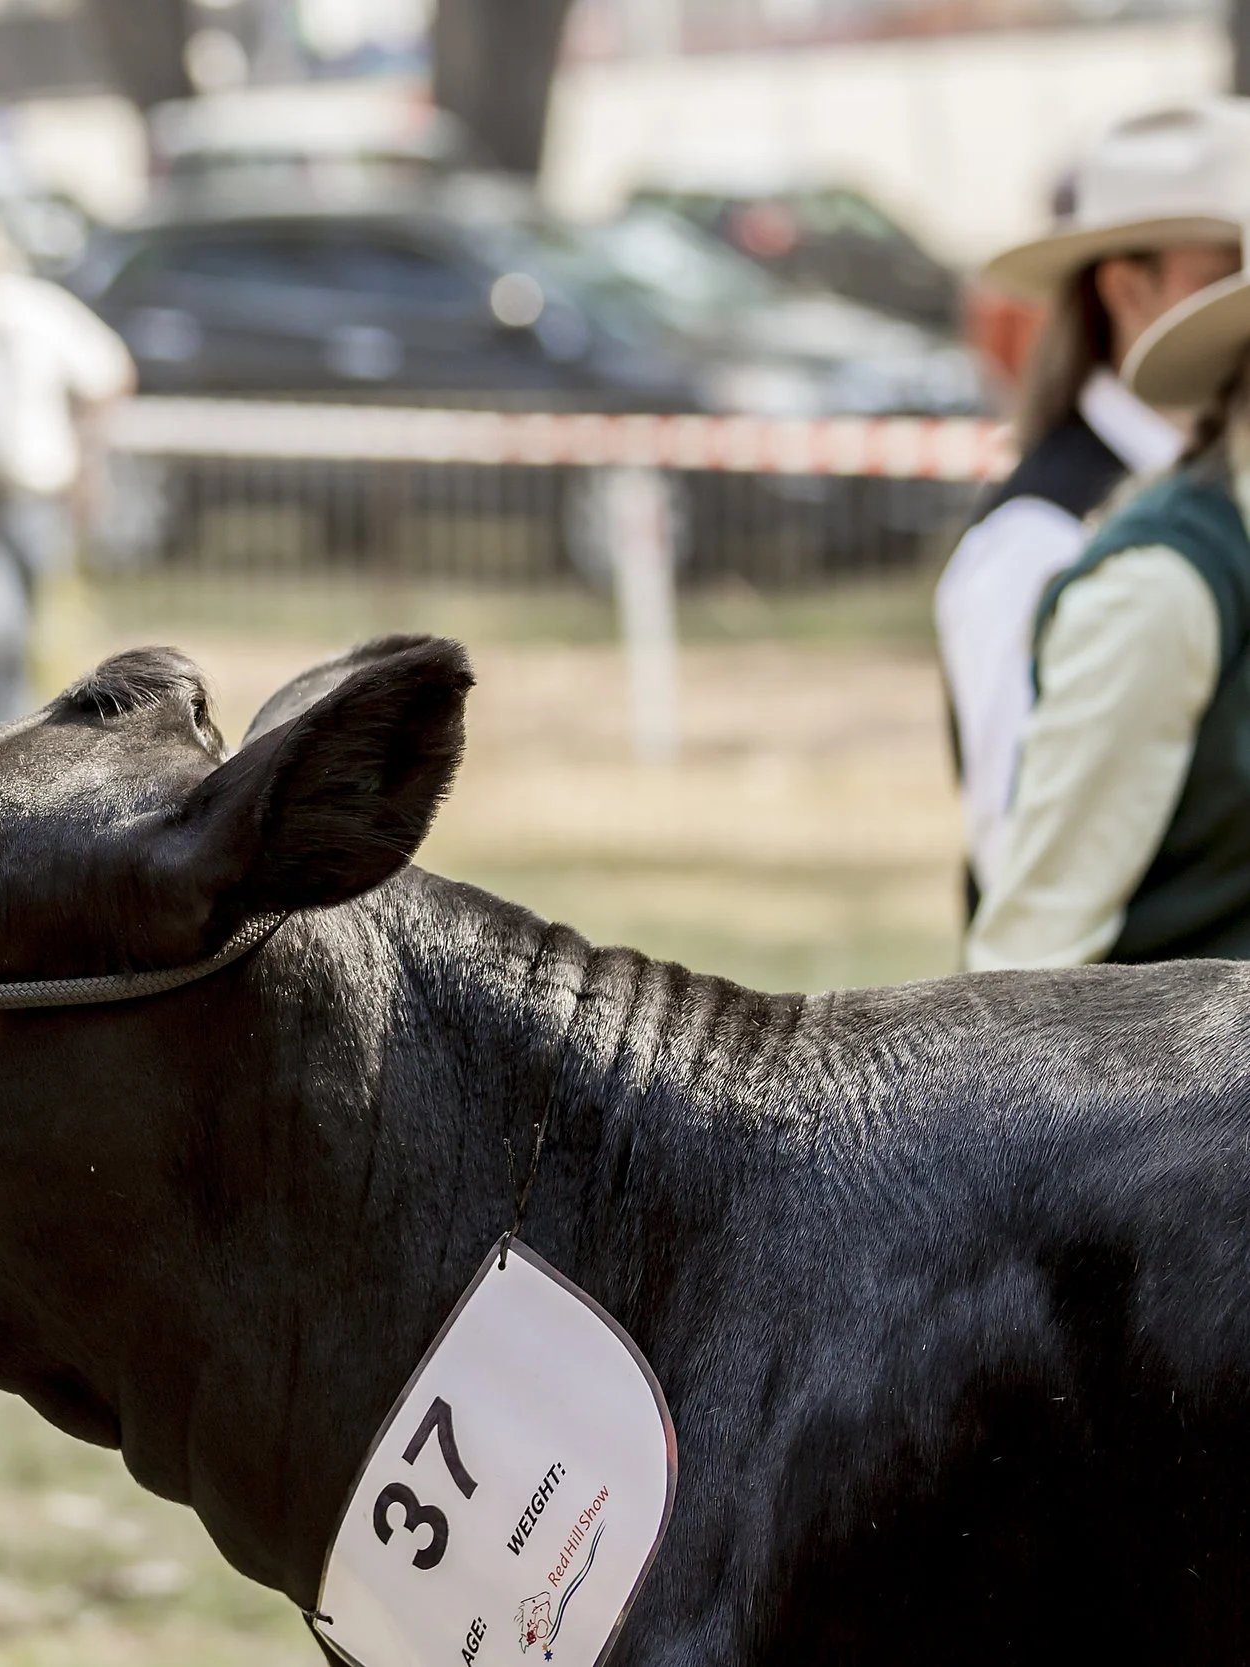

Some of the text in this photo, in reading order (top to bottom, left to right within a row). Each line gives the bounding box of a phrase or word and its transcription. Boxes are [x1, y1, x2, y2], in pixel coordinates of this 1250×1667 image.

[372, 1395, 479, 1571] 37
[506, 1462, 566, 1557] WEIGHT:
[548, 1485, 610, 1588] Red Hill Show
[461, 1616, 488, 1667] AGE:
